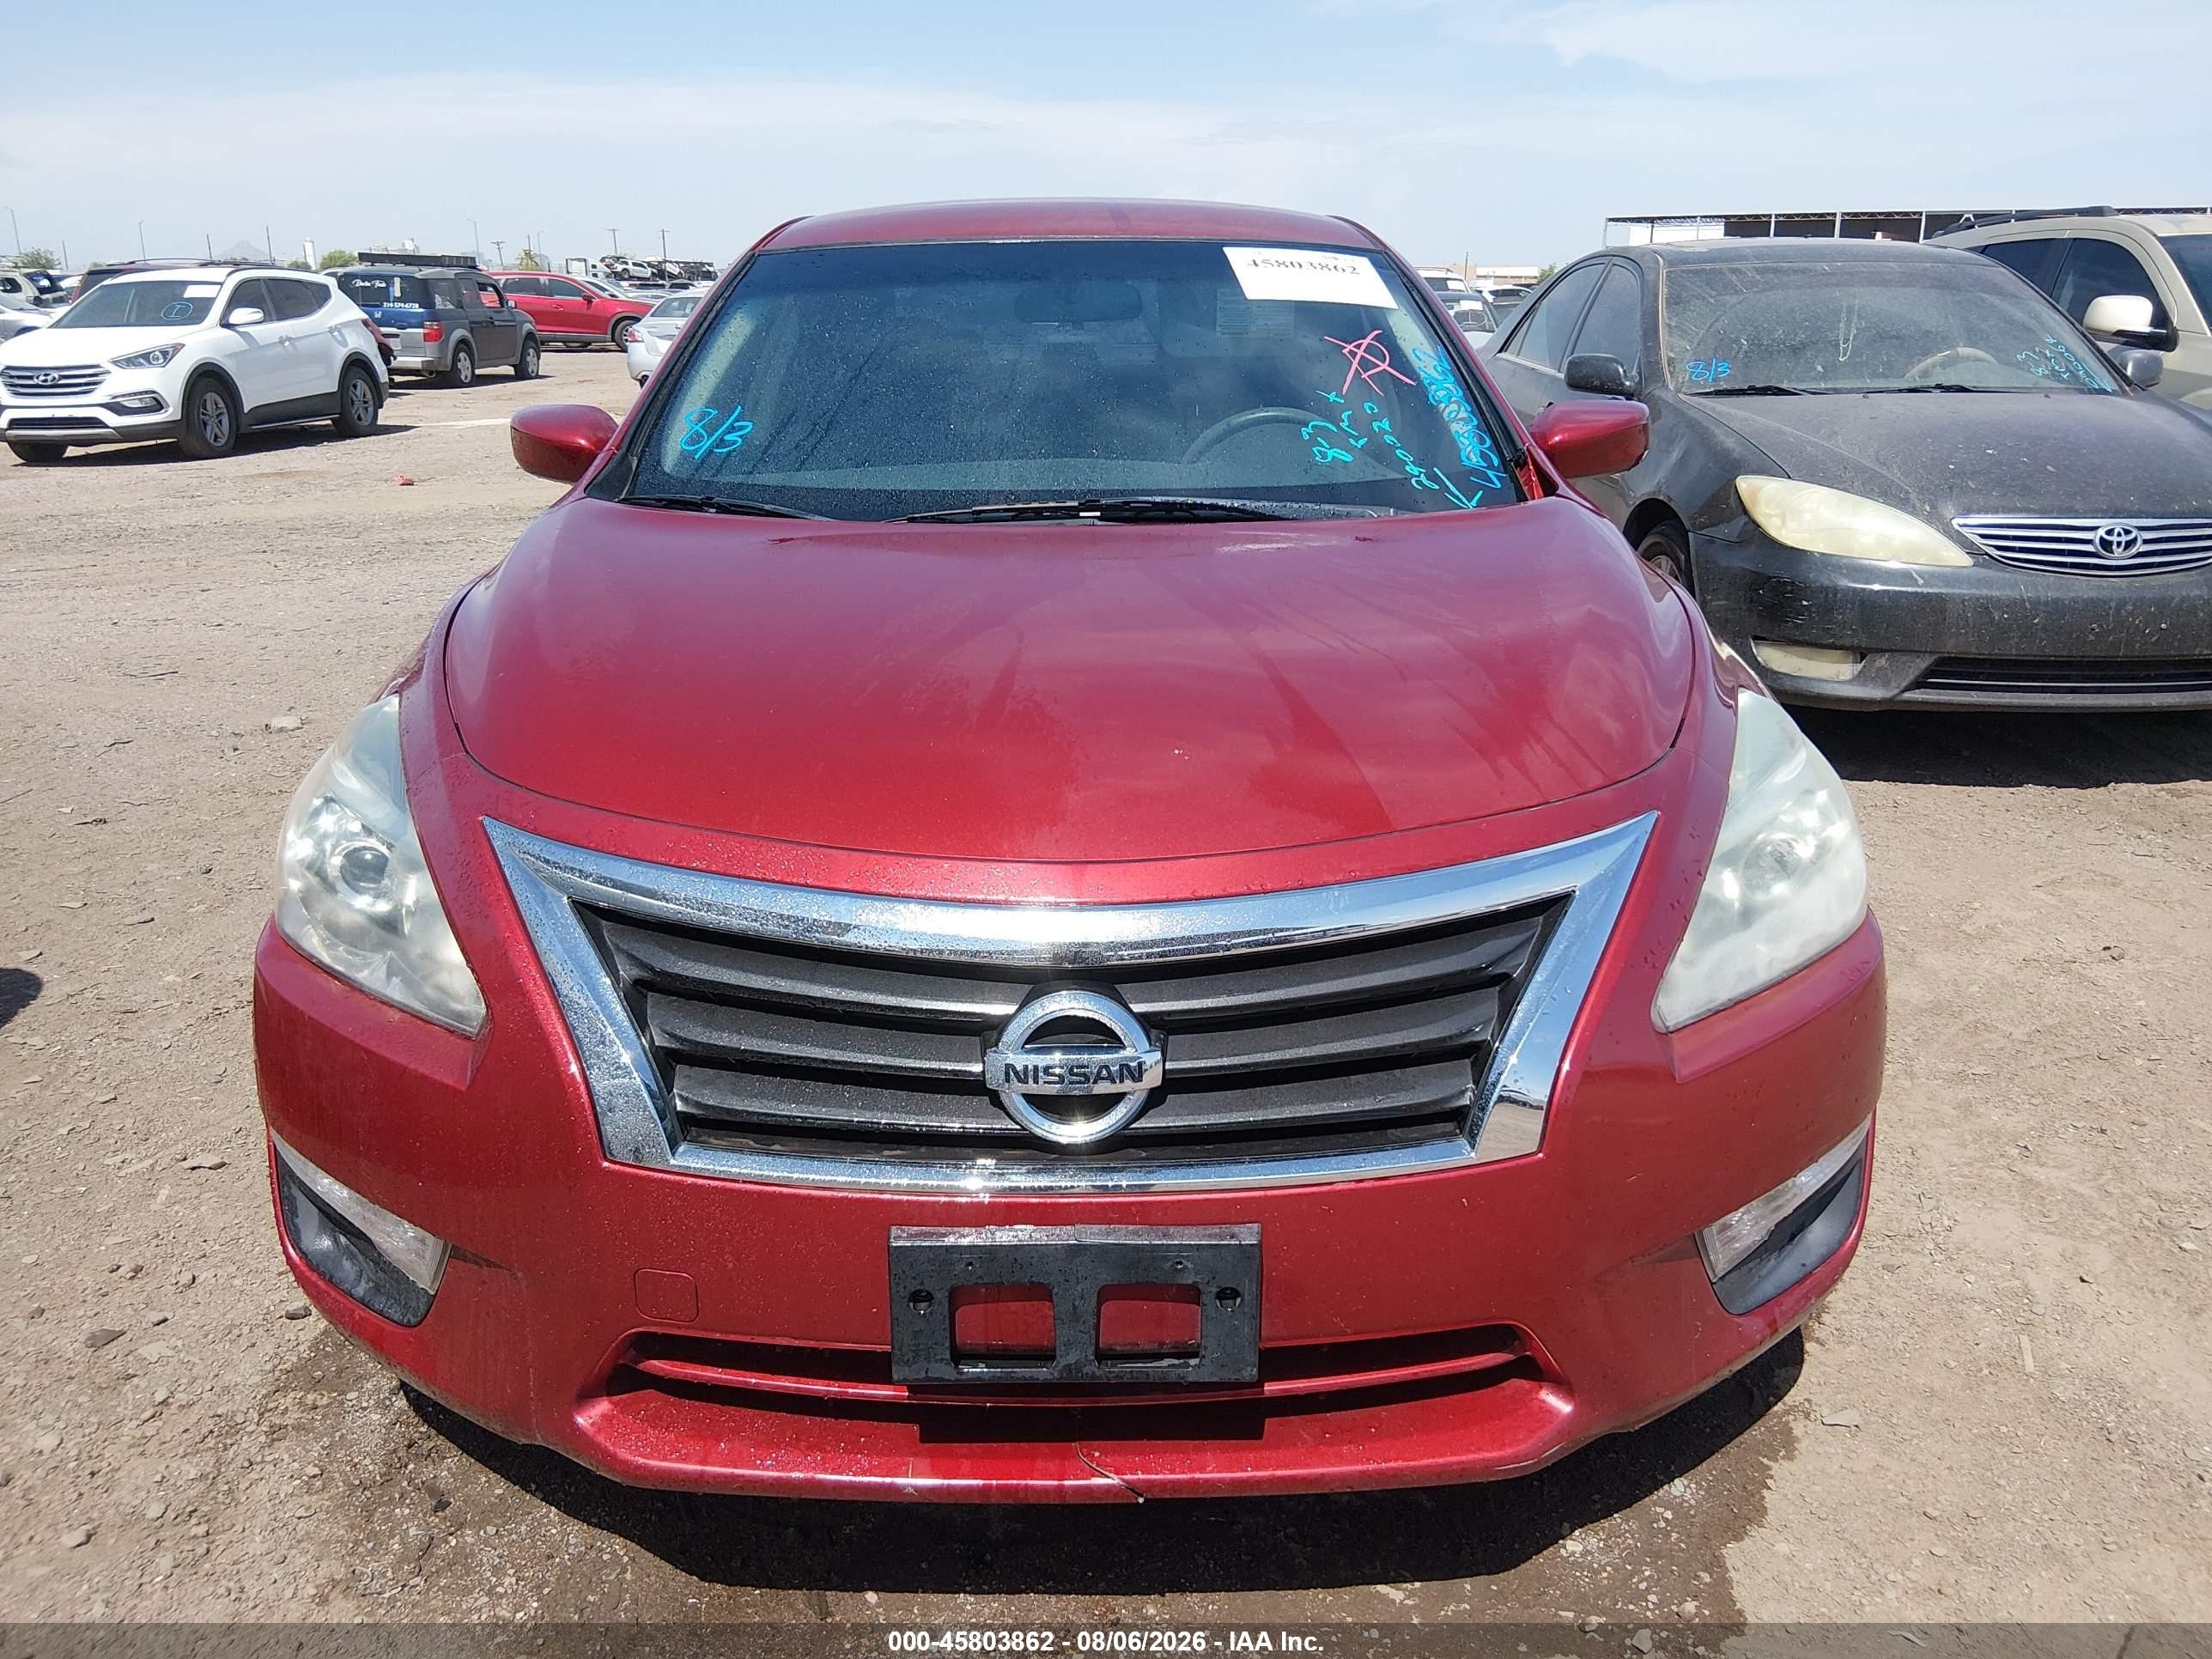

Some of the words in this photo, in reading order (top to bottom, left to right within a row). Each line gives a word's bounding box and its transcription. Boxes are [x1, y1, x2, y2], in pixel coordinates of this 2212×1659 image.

[1686, 357, 1731, 382] 8/3
[679, 405, 753, 460] 8/3
[1004, 1060, 1146, 1085] NISSAN
